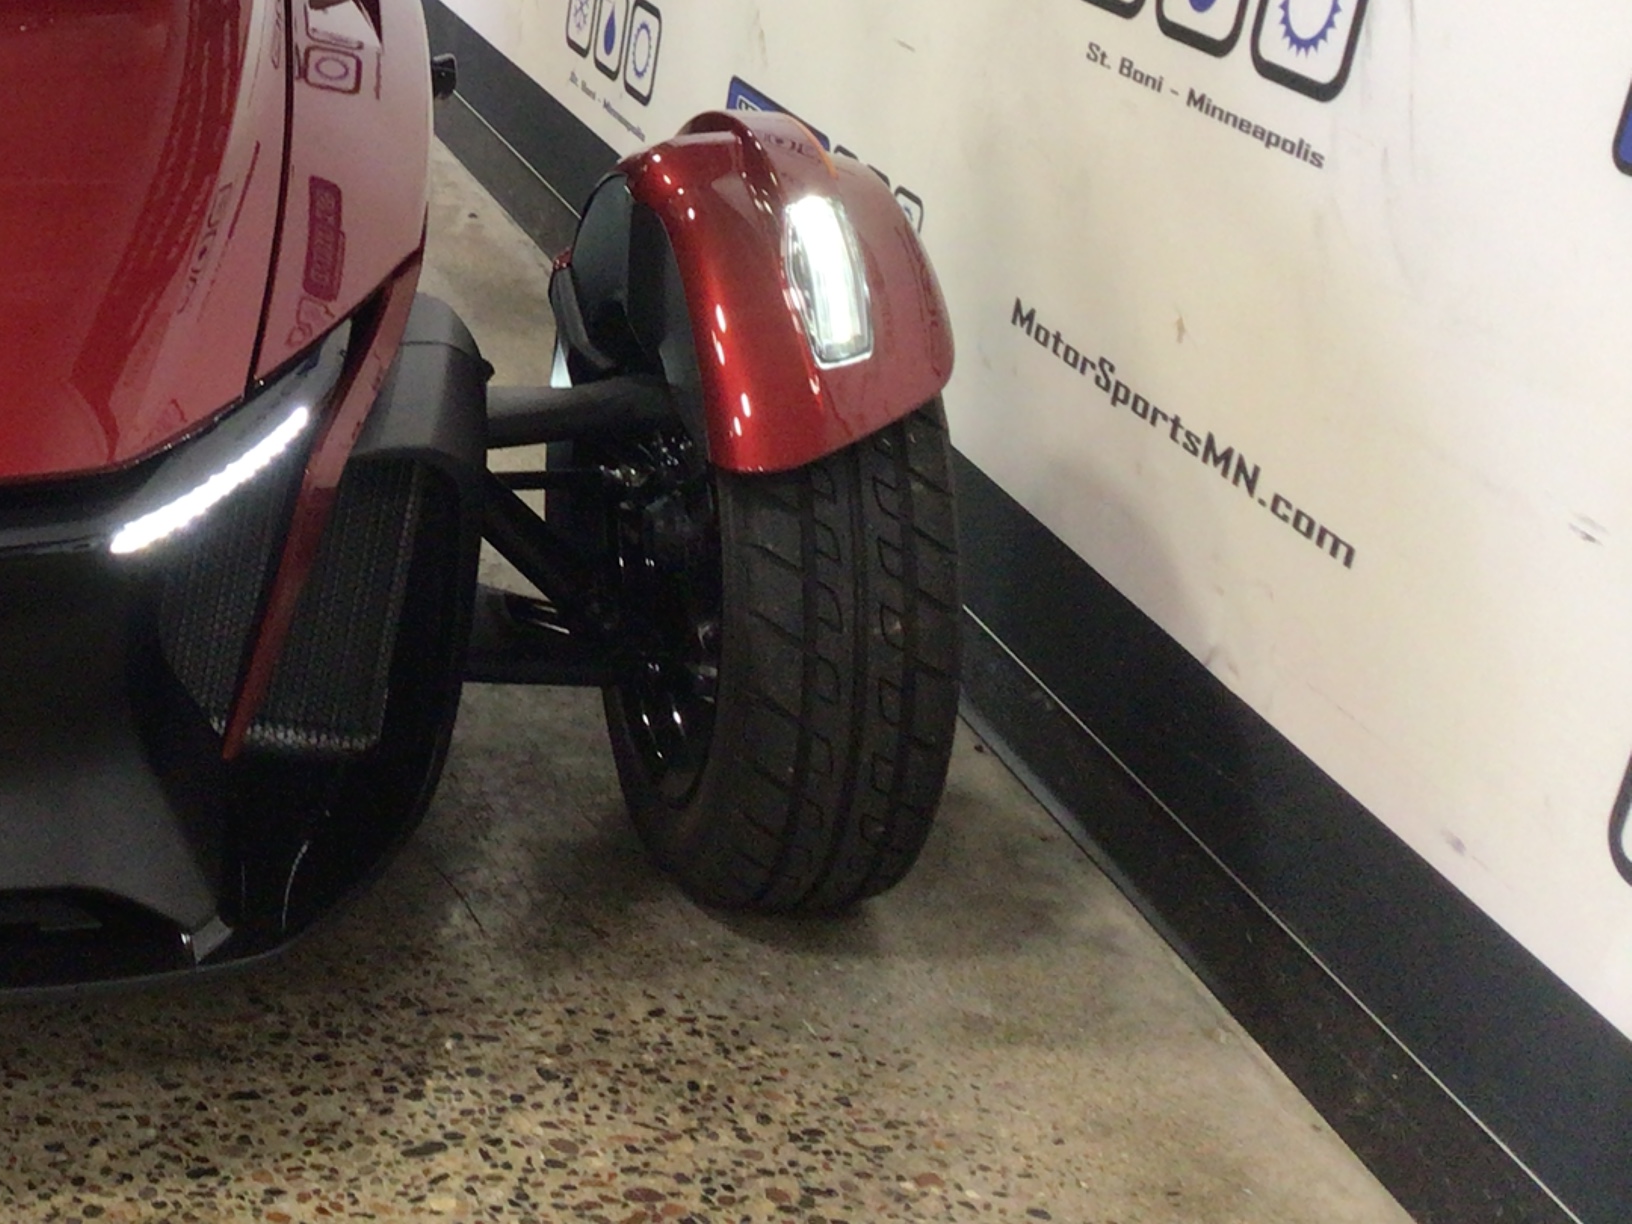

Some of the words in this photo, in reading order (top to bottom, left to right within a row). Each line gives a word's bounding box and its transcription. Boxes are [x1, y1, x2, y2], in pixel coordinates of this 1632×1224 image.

[1086, 41, 1112, 70] St.
[1118, 56, 1164, 94] Boni
[1185, 87, 1326, 169] Minneapolis
[1011, 296, 1357, 570] MotorSportsMN.com
